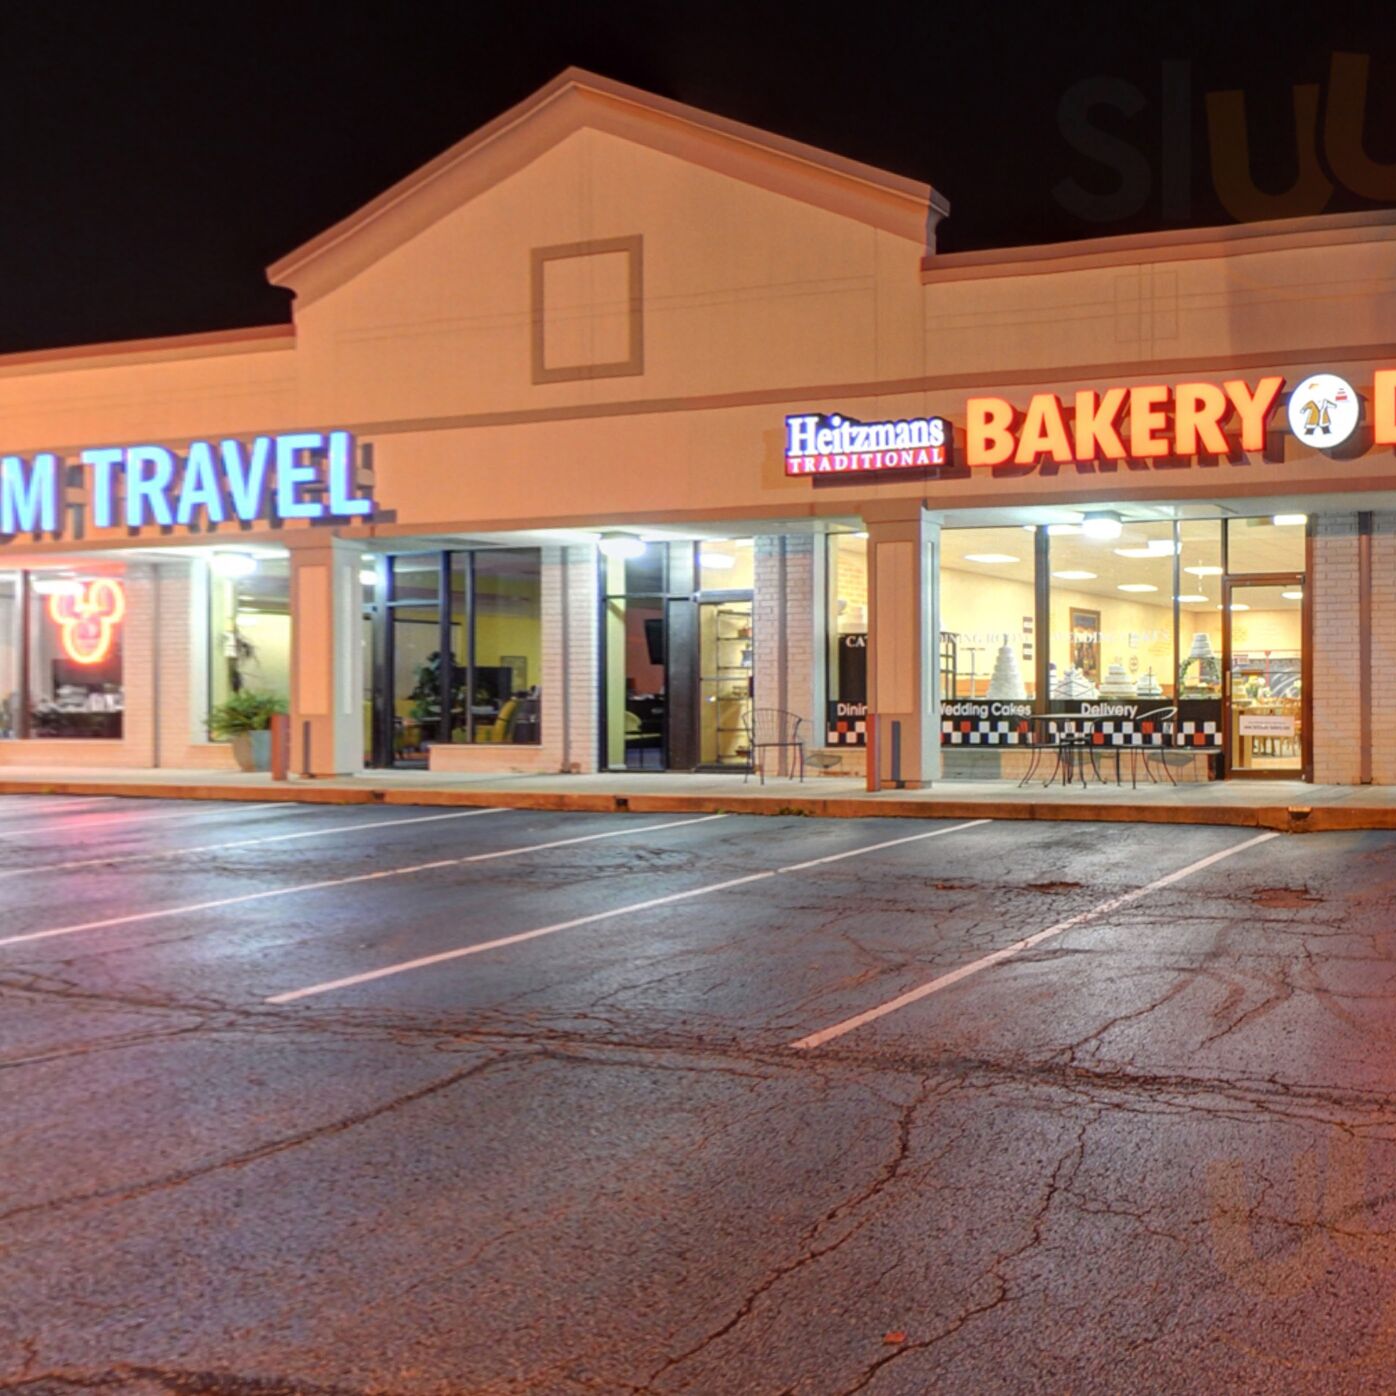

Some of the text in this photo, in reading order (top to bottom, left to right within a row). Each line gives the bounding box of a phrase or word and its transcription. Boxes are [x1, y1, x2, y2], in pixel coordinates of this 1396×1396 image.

[966, 375, 1285, 467] BAKERY
[787, 415, 945, 456] Heitzmans
[789, 449, 944, 474] TRADITIONAL
[0, 430, 371, 534] M TRAVEL
[846, 635, 868, 648] CA
[837, 702, 868, 716] Dinin
[991, 702, 1031, 716] Cakes
[1081, 702, 1138, 719] Delivery
